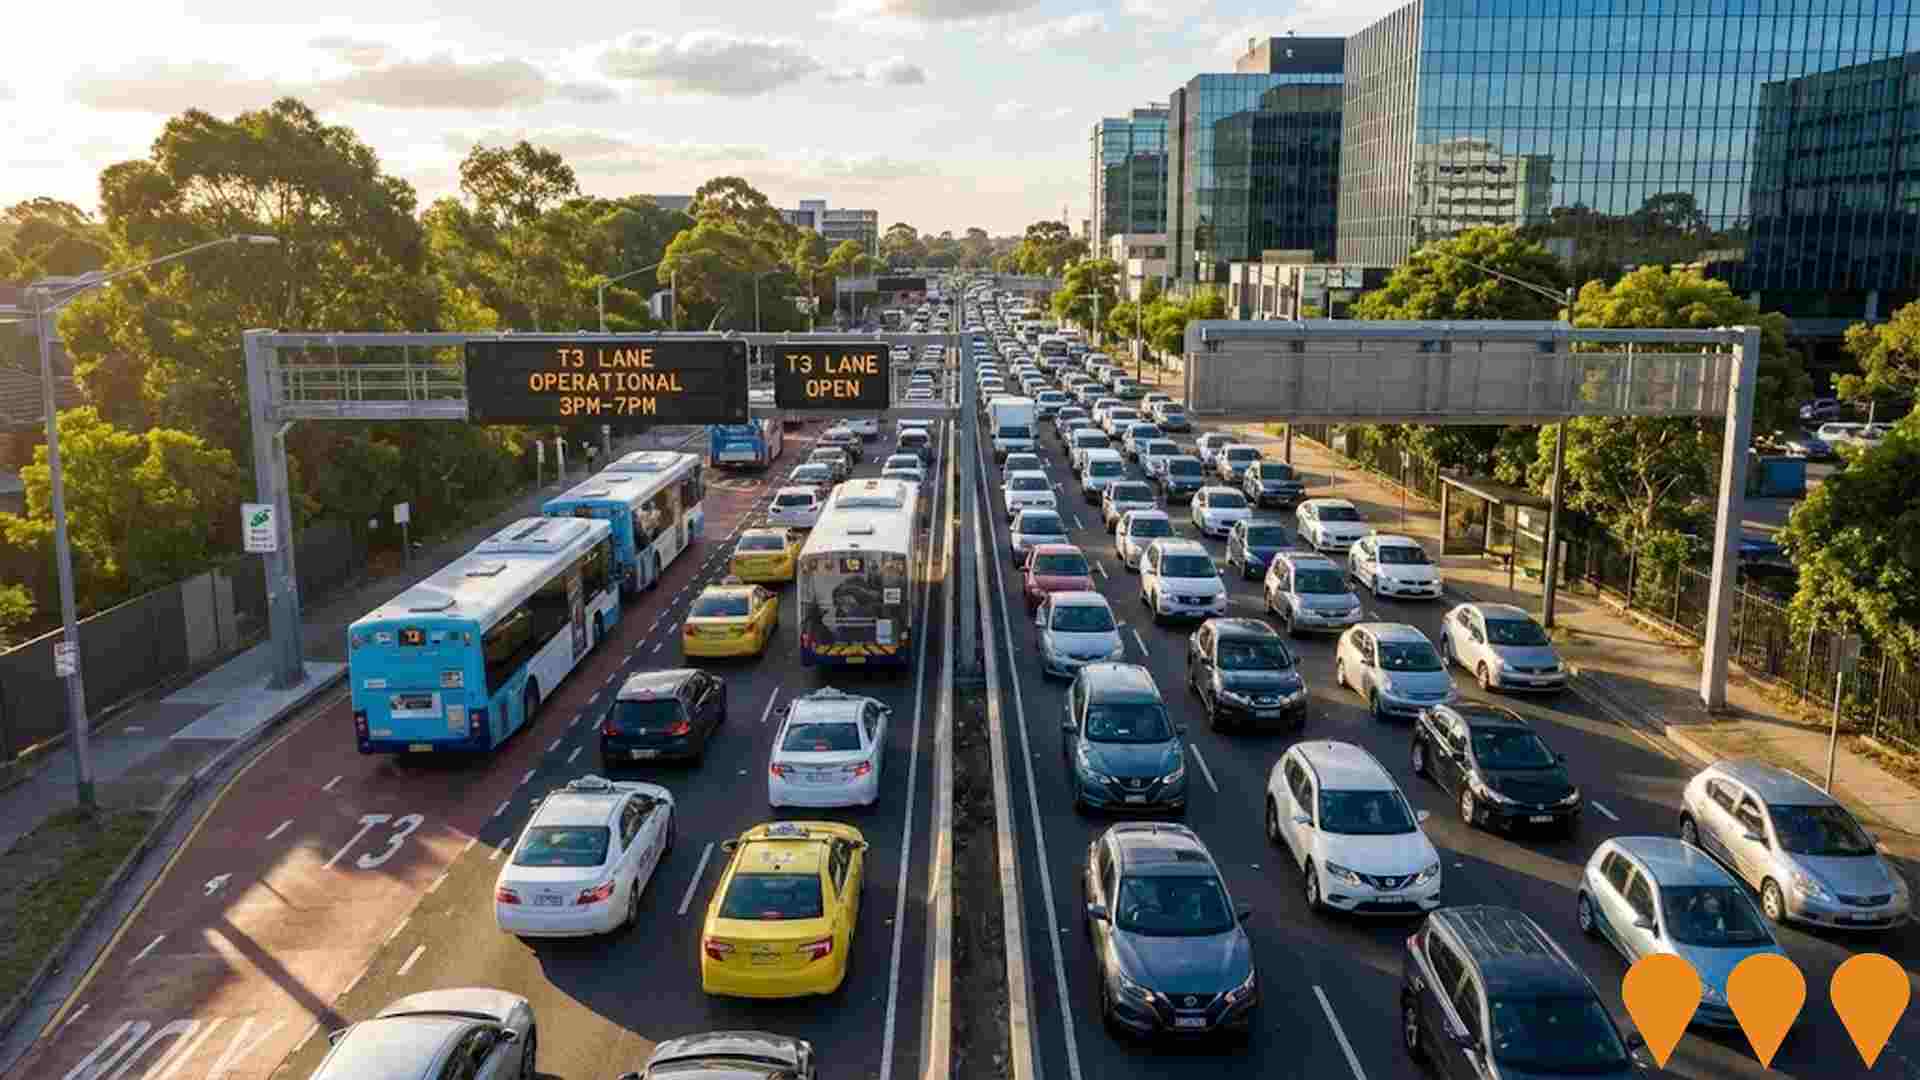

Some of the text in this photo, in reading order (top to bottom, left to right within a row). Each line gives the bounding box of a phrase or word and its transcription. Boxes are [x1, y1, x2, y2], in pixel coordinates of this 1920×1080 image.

[558, 349, 655, 369] T3 LANE
[786, 355, 879, 374] T3 LANE
[529, 372, 683, 392] OPERATIONAL
[805, 379, 860, 398] OPEN
[559, 396, 657, 416] 3PM-7PM
[320, 814, 425, 869] T3
